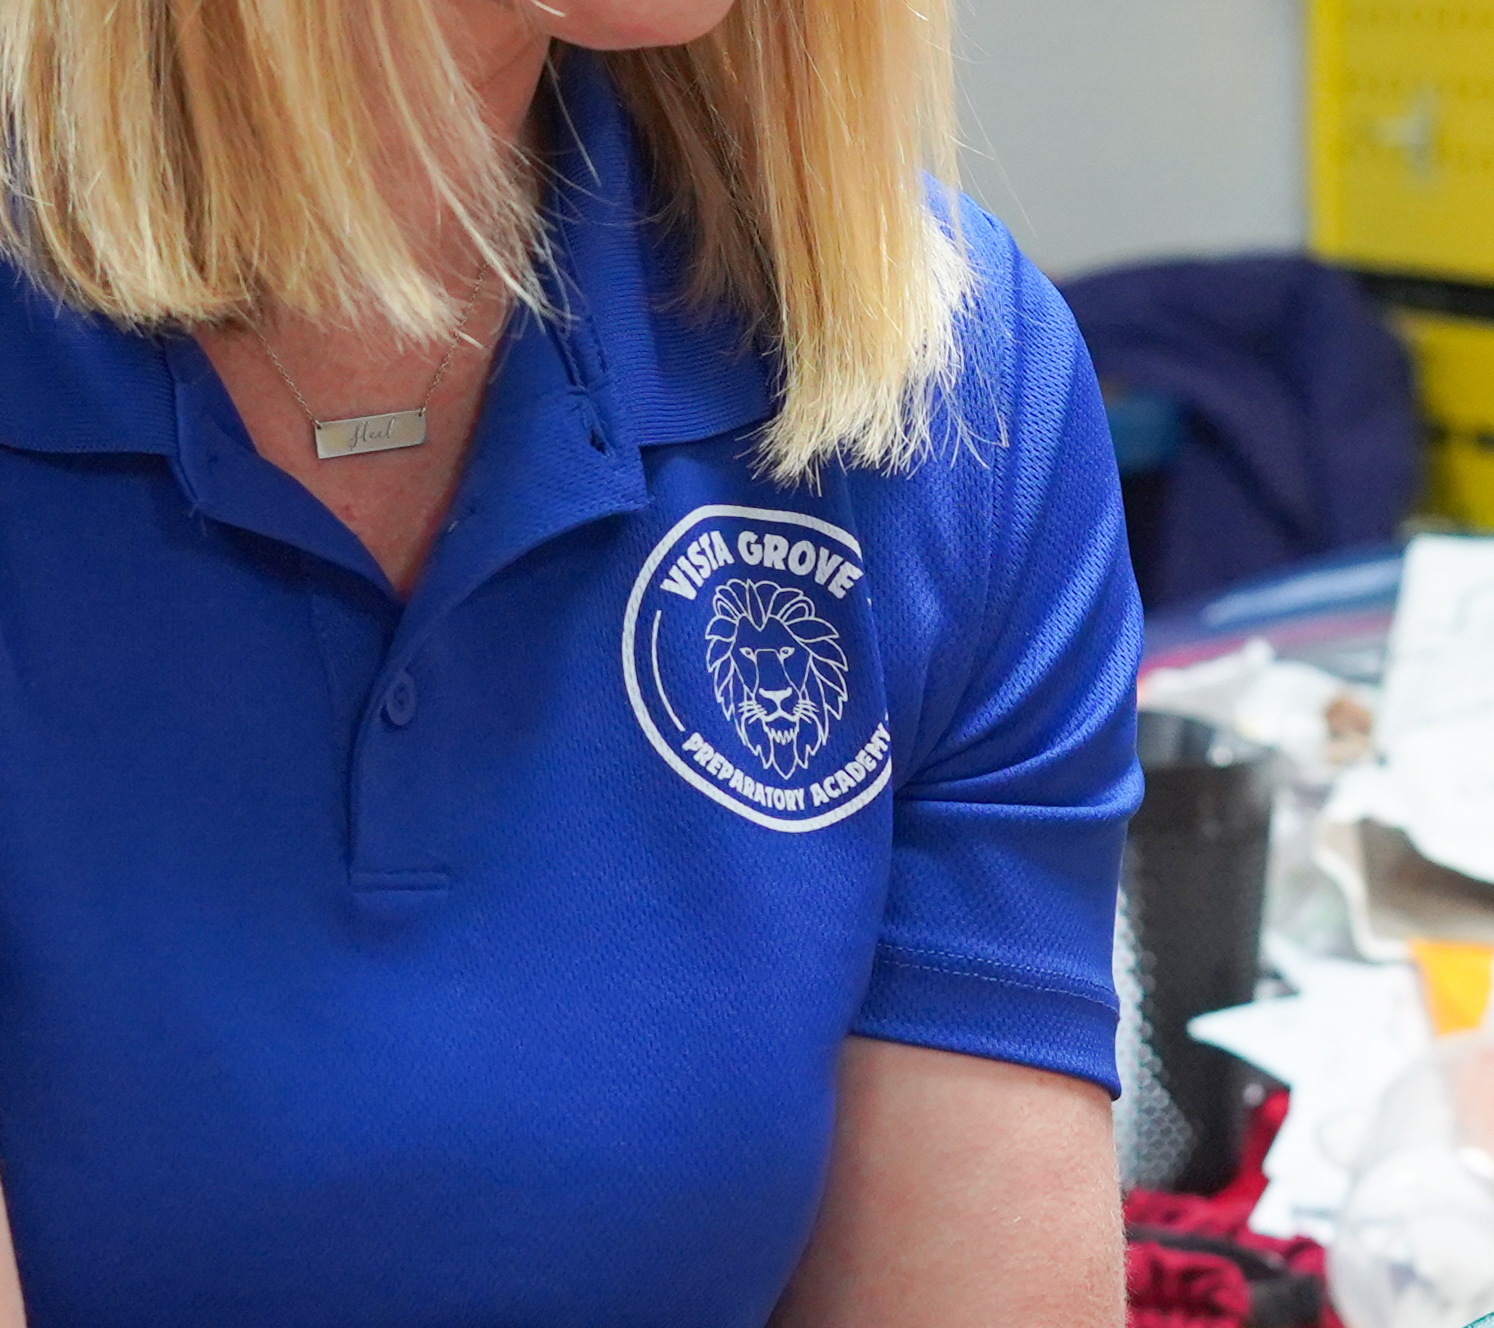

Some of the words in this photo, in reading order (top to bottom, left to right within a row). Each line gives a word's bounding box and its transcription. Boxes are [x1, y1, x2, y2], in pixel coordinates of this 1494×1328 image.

[660, 531, 734, 600] VISTA
[737, 531, 863, 599] GROVE
[682, 732, 804, 811] PREPARATORY
[809, 722, 891, 806] ACADEMY
